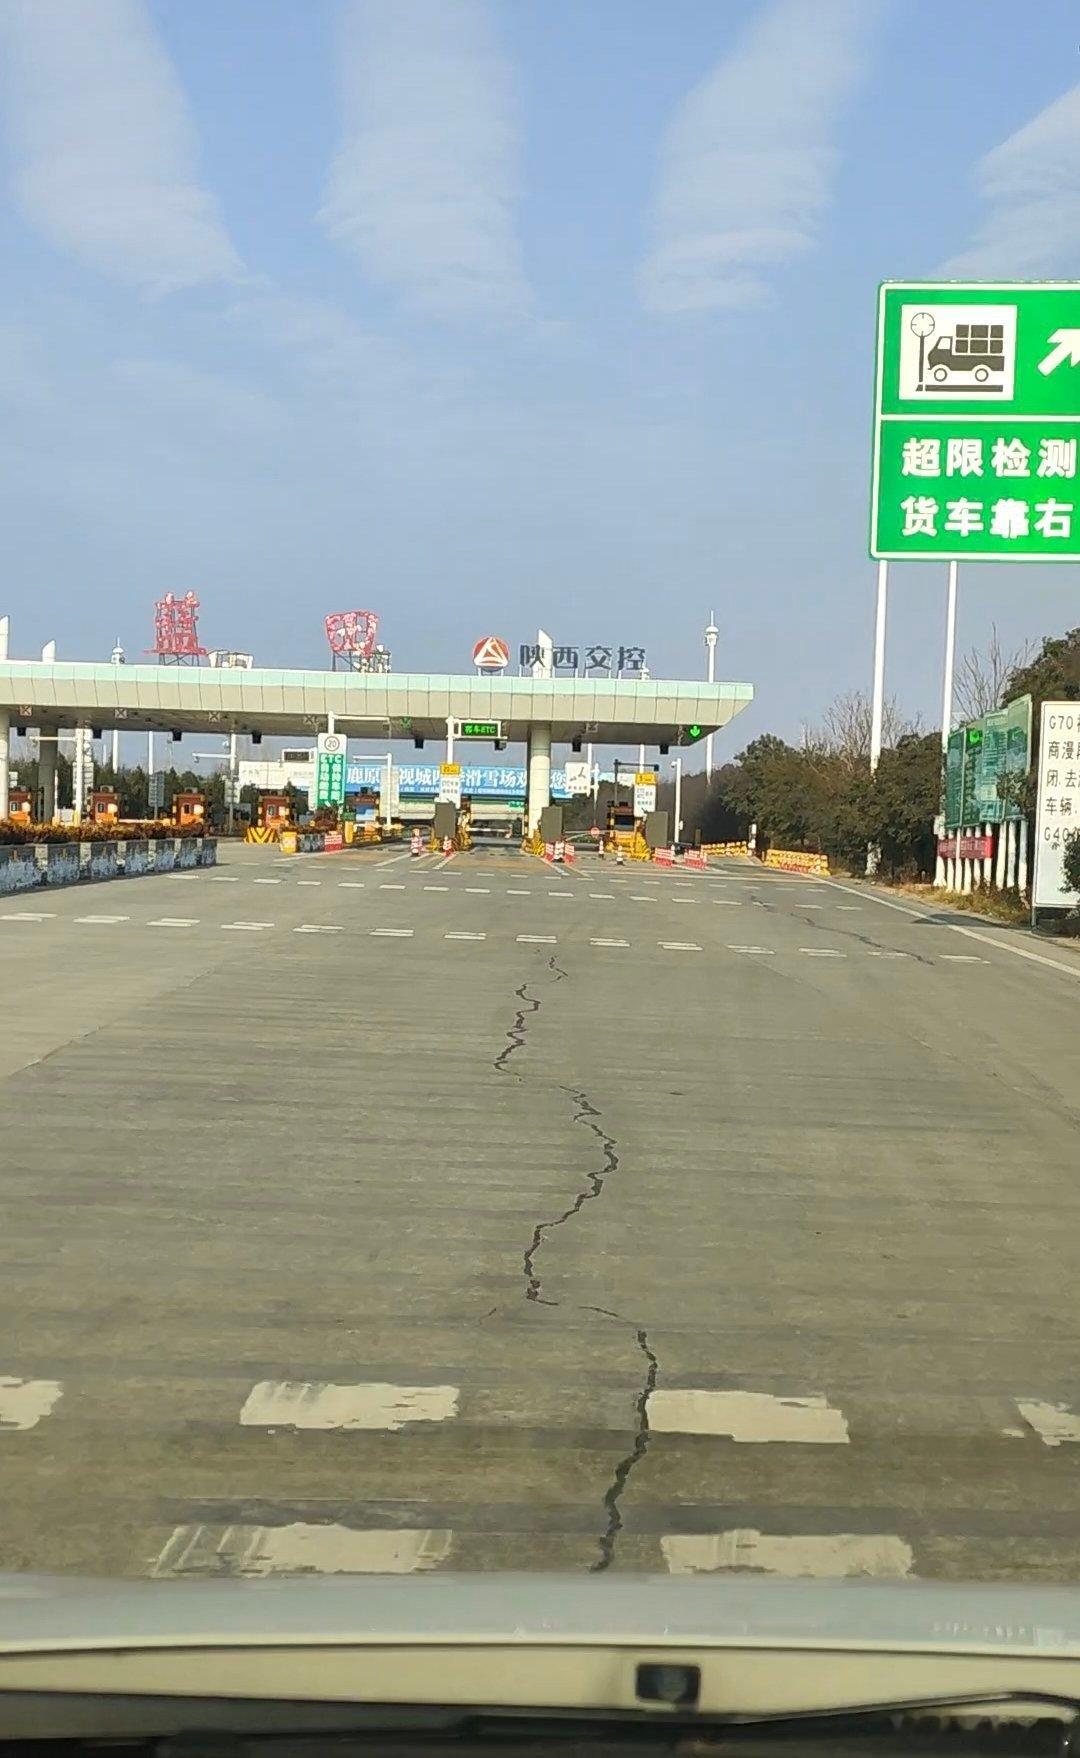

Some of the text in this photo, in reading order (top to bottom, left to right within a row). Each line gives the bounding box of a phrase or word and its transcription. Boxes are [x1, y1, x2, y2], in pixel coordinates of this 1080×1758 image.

[901, 437, 1077, 478] 超限检测
[900, 496, 1074, 539] 货车靠右
[519, 644, 646, 671] 陕西交控
[1047, 741, 1080, 760] 商漫
